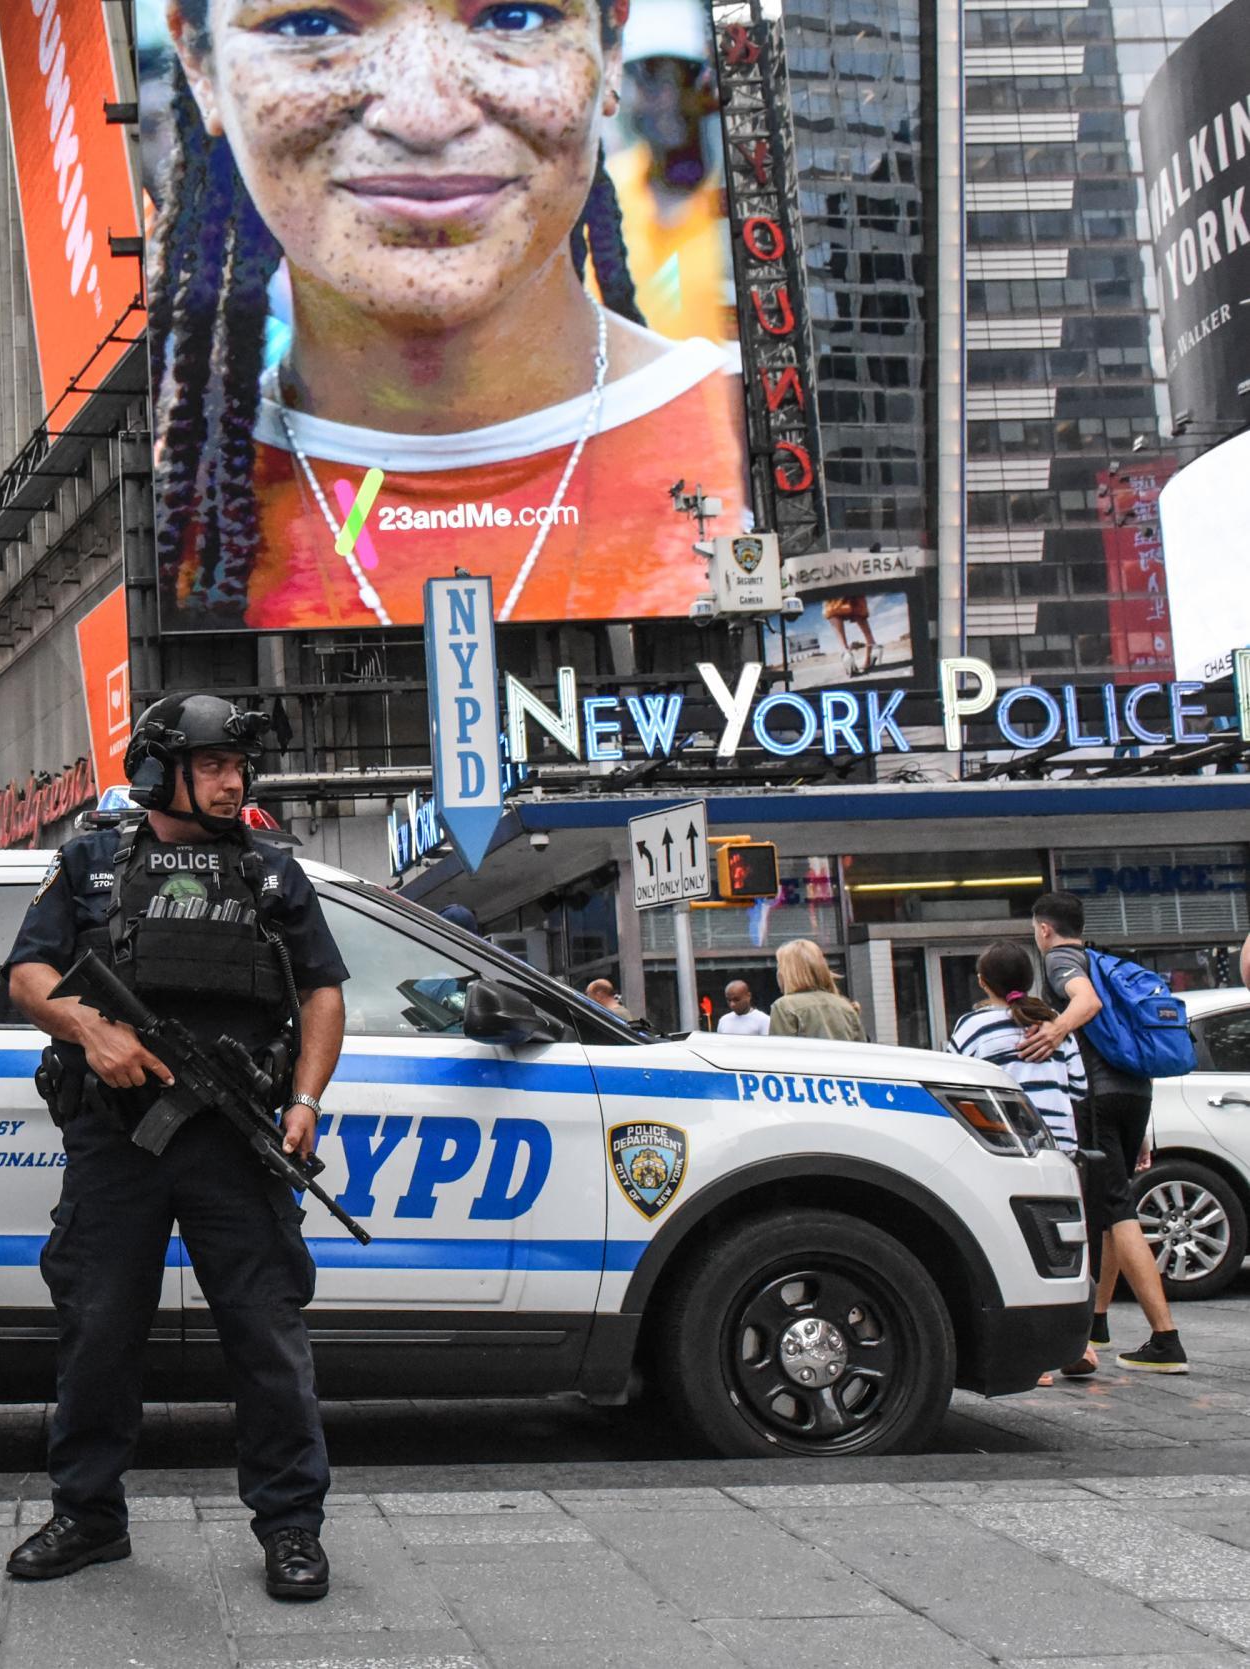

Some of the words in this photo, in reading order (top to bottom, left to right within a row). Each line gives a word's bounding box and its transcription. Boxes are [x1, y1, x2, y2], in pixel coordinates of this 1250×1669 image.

[1165, 186, 1250, 300] YORK
[1177, 303, 1231, 357] WALKER
[378, 502, 579, 530] 23andMe.com
[788, 556, 913, 586] NBCUNIVERSAL
[1204, 655, 1233, 678] CHAS
[446, 588, 486, 799] NYPD
[697, 661, 910, 759] YORK
[939, 656, 1209, 751] POLICE
[150, 853, 220, 870] POLICE
[637, 883, 657, 900] ONLY
[659, 879, 679, 896] ONLY
[683, 873, 705, 891] ONLY
[739, 1073, 859, 1108] POLICE
[613, 1135, 683, 1152] DEPARTMENT
[627, 1125, 668, 1137] POLICE
[615, 1163, 631, 1186] CITY
[628, 1189, 642, 1202] OF
[655, 1186, 673, 1207] NEW
[670, 1159, 684, 1183] YORK
